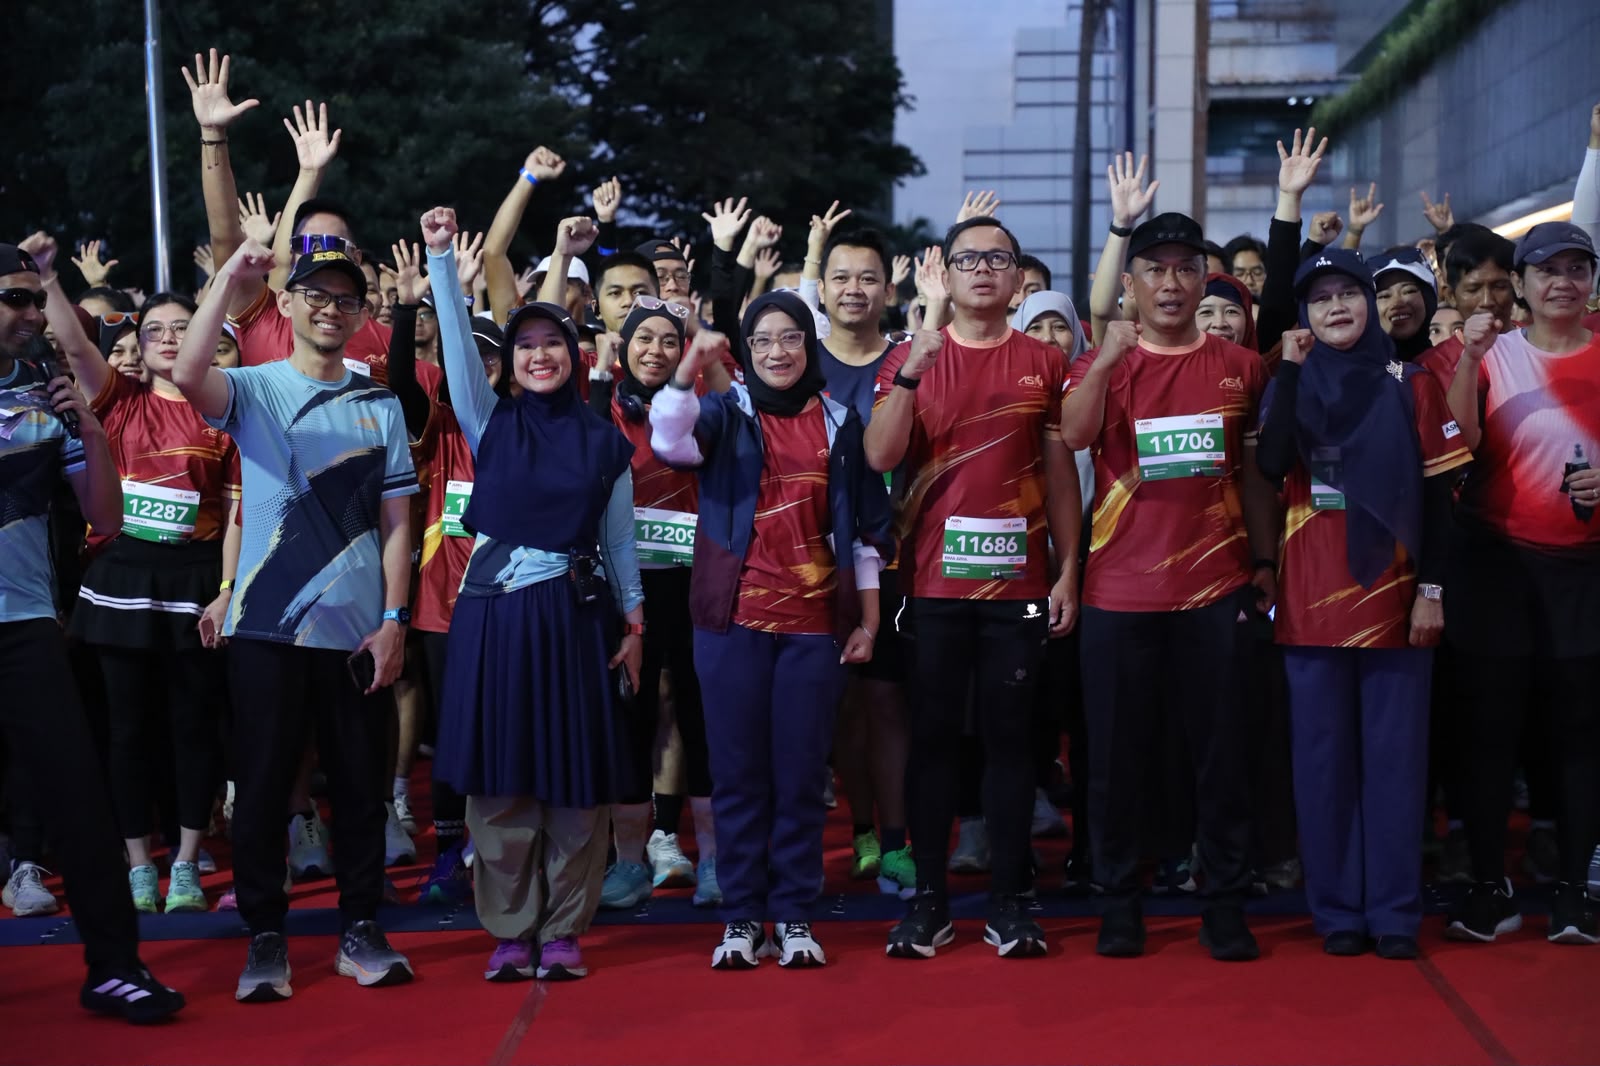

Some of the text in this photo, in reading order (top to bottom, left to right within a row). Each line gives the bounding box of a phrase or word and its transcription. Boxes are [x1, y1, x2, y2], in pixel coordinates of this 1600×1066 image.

[1149, 432, 1215, 453] 11706
[129, 498, 189, 522] 12287
[445, 505, 452, 513] F
[640, 523, 696, 544] 12209
[945, 535, 1018, 554] M 11686
